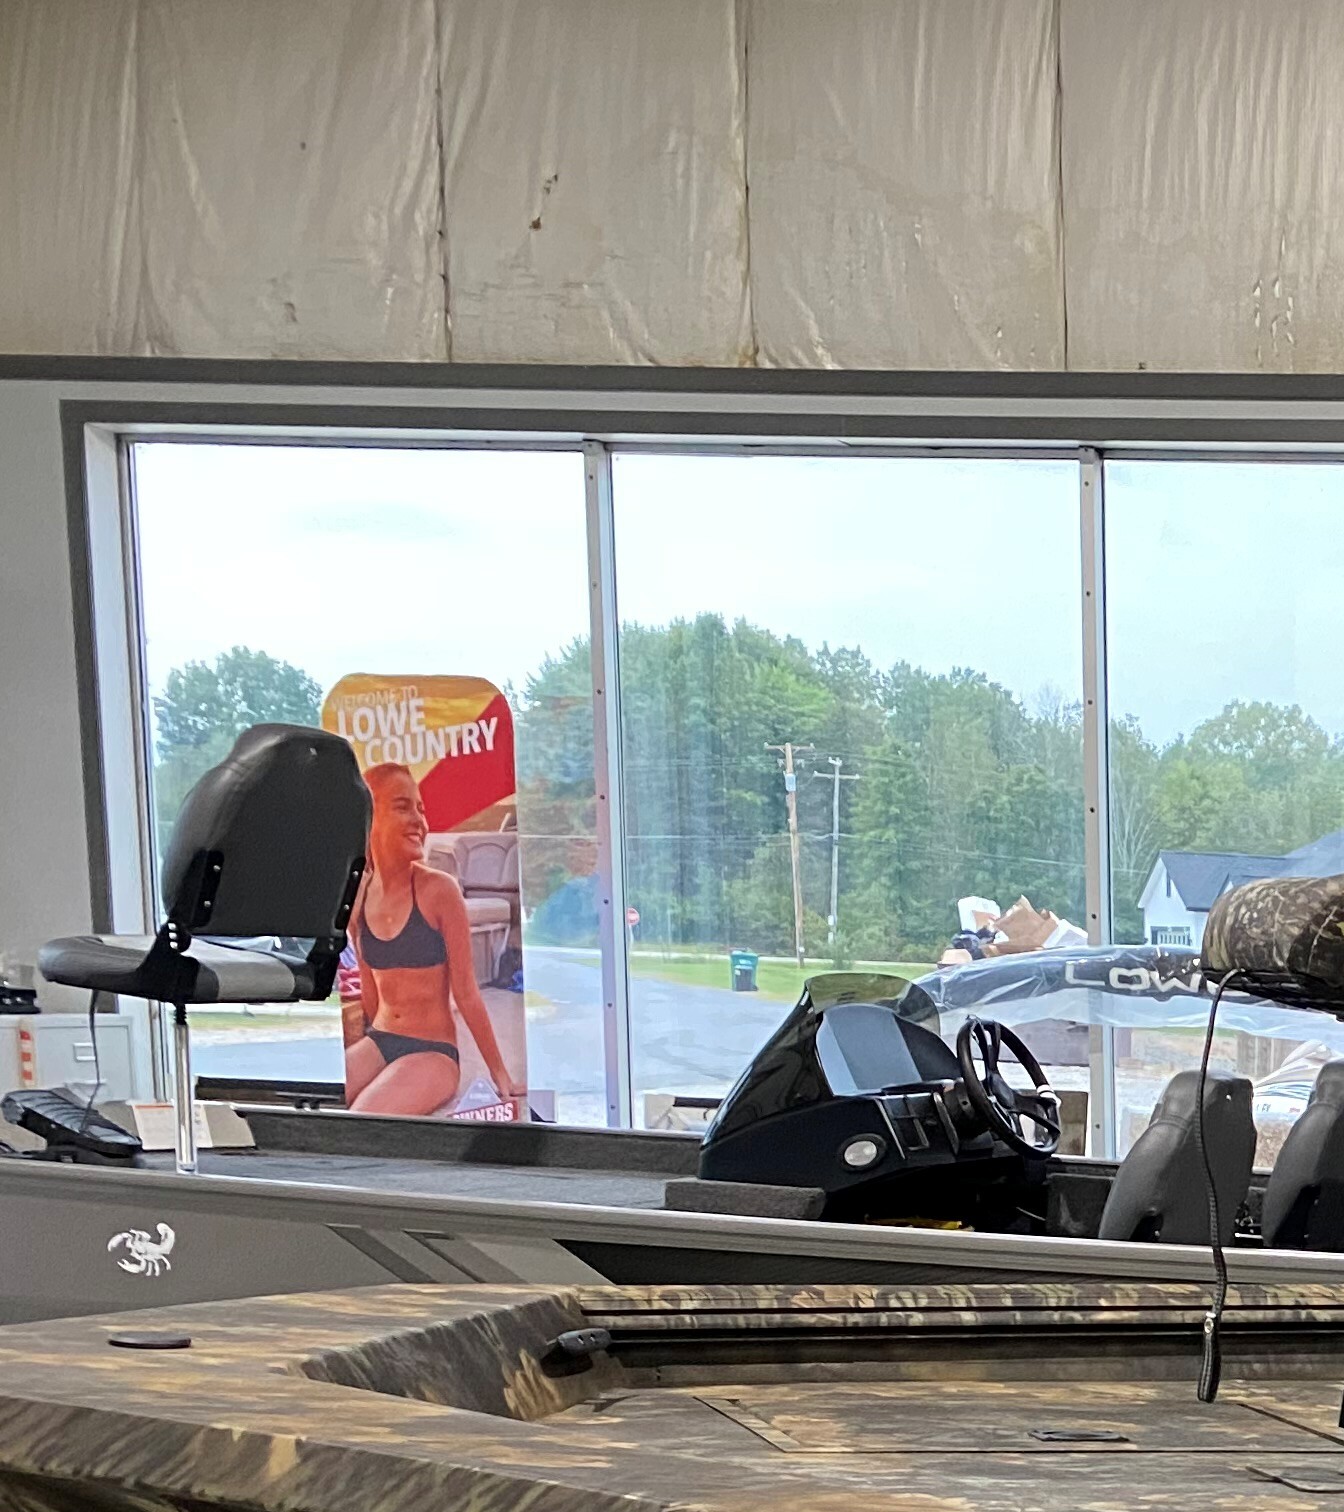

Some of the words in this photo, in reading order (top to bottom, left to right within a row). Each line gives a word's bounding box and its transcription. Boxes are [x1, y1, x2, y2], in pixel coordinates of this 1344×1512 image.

[331, 688, 396, 709] WELCOME
[403, 685, 418, 700] TO
[337, 698, 426, 743] LOWE
[365, 717, 498, 767] COUNTRY
[453, 1102, 514, 1121] NERS
